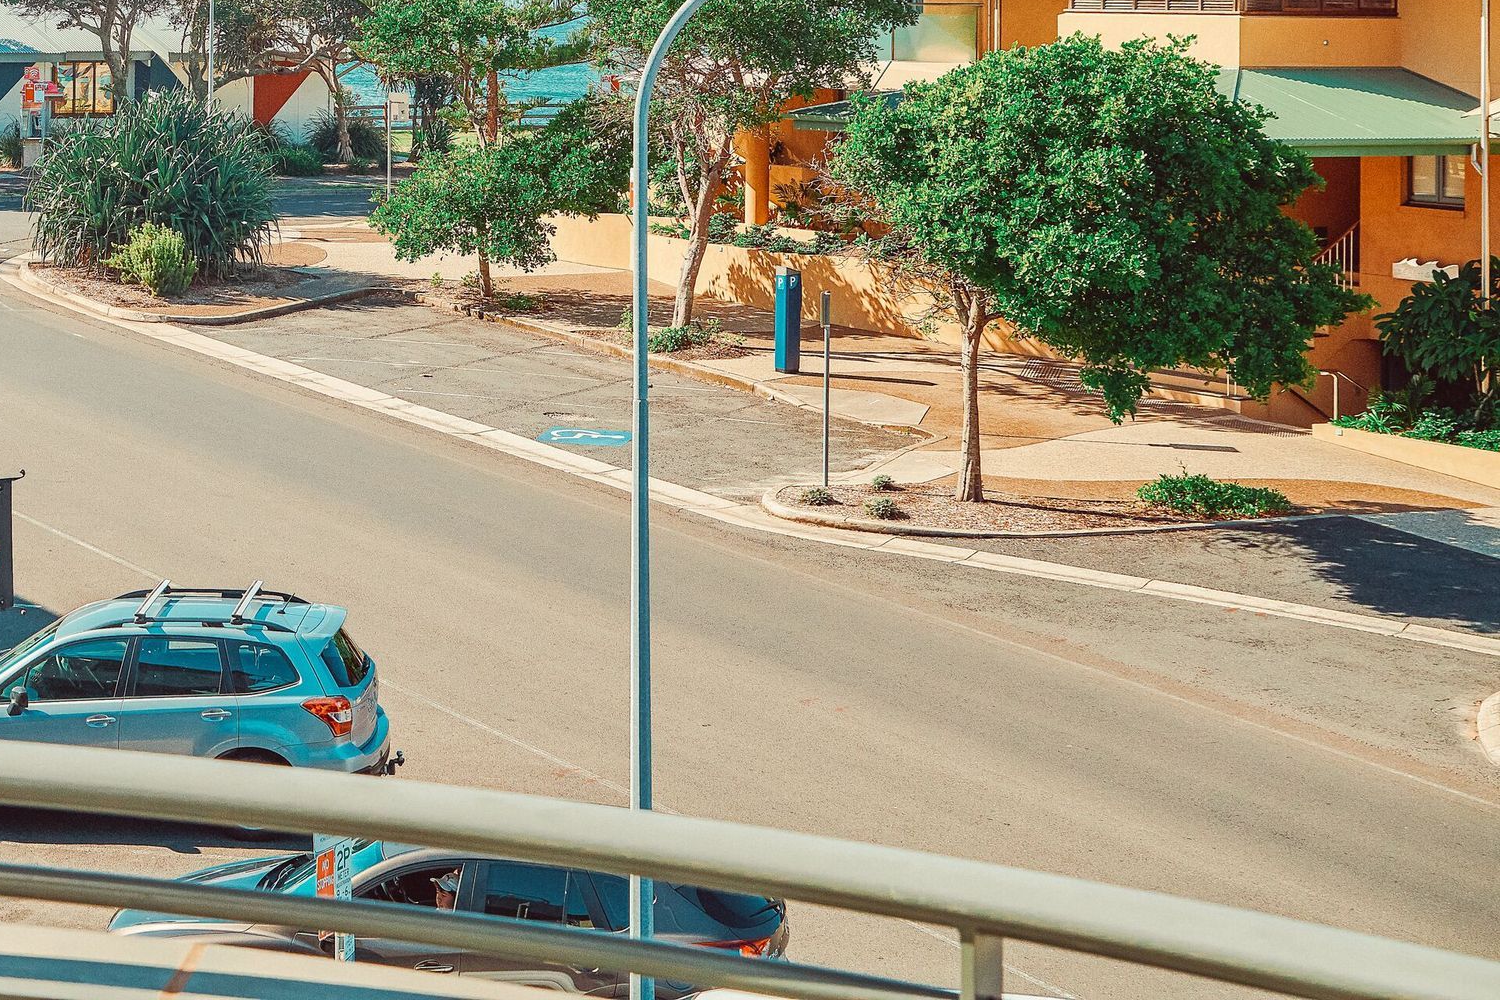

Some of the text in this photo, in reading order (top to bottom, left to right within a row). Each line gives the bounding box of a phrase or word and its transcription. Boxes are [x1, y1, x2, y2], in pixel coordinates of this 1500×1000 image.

[321, 858, 330, 872] NO
[336, 847, 351, 872] 2P
[337, 868, 349, 880] METER
[317, 874, 334, 891] STOPPING
